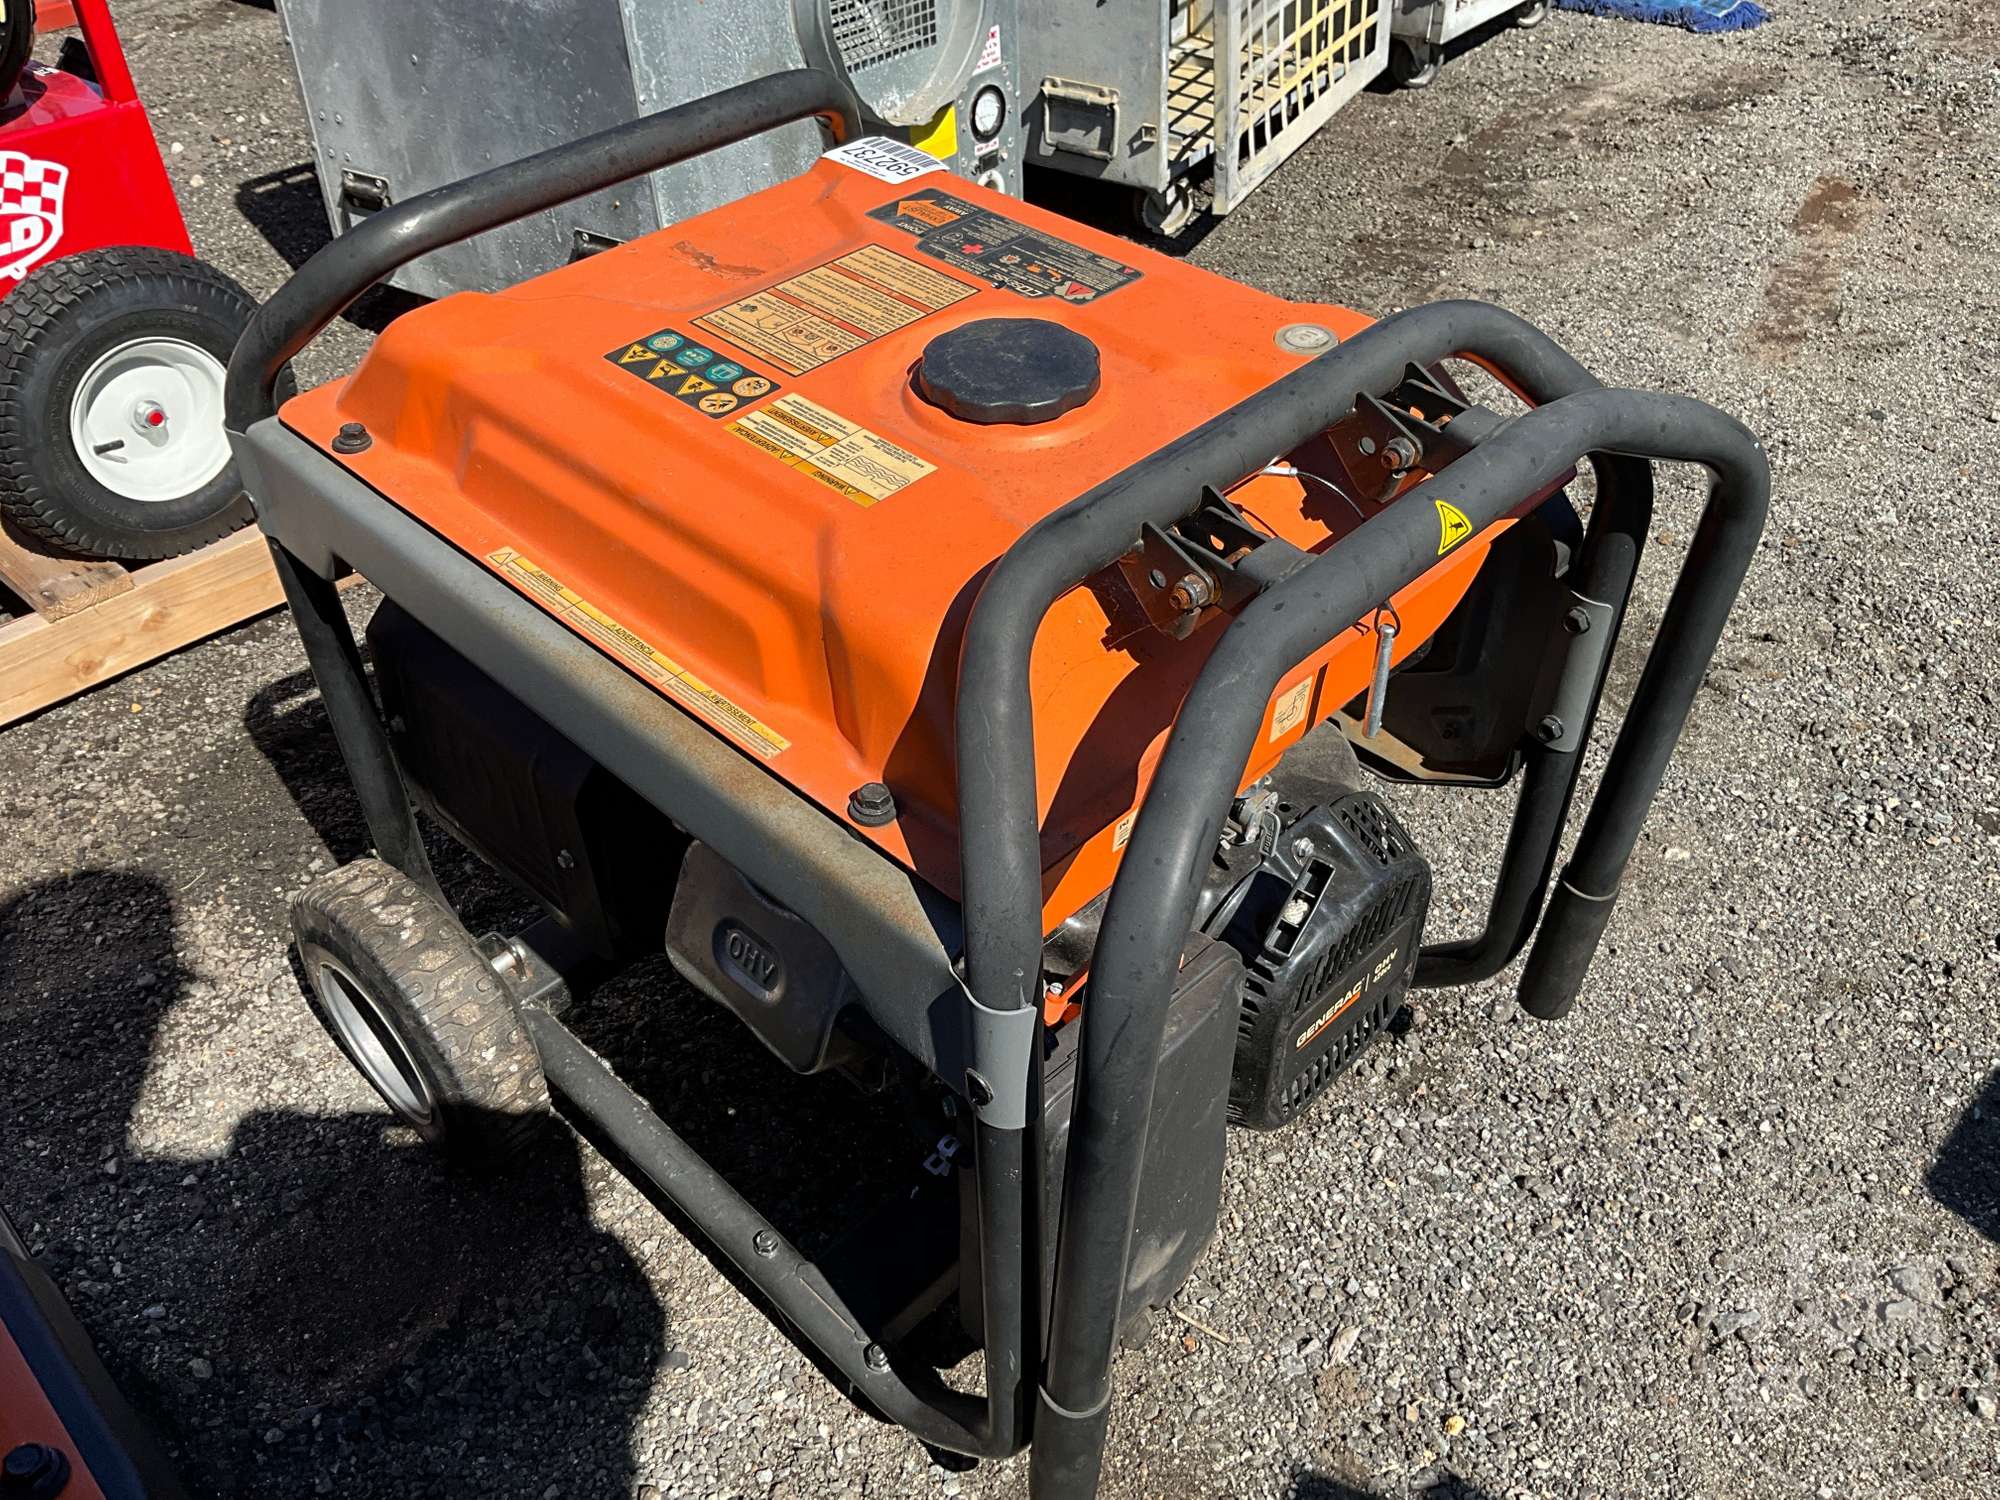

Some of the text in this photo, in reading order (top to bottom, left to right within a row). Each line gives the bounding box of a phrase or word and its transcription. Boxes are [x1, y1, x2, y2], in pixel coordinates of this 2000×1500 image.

[841, 146, 920, 176] 592737
[537, 572, 564, 593] WARNING
[614, 627, 656, 657] ADVERTENCIA
[710, 691, 757, 727] AVERTISSEMENT
[727, 932, 776, 984] OHV
[1296, 947, 1399, 1048] GENERAC OHV
